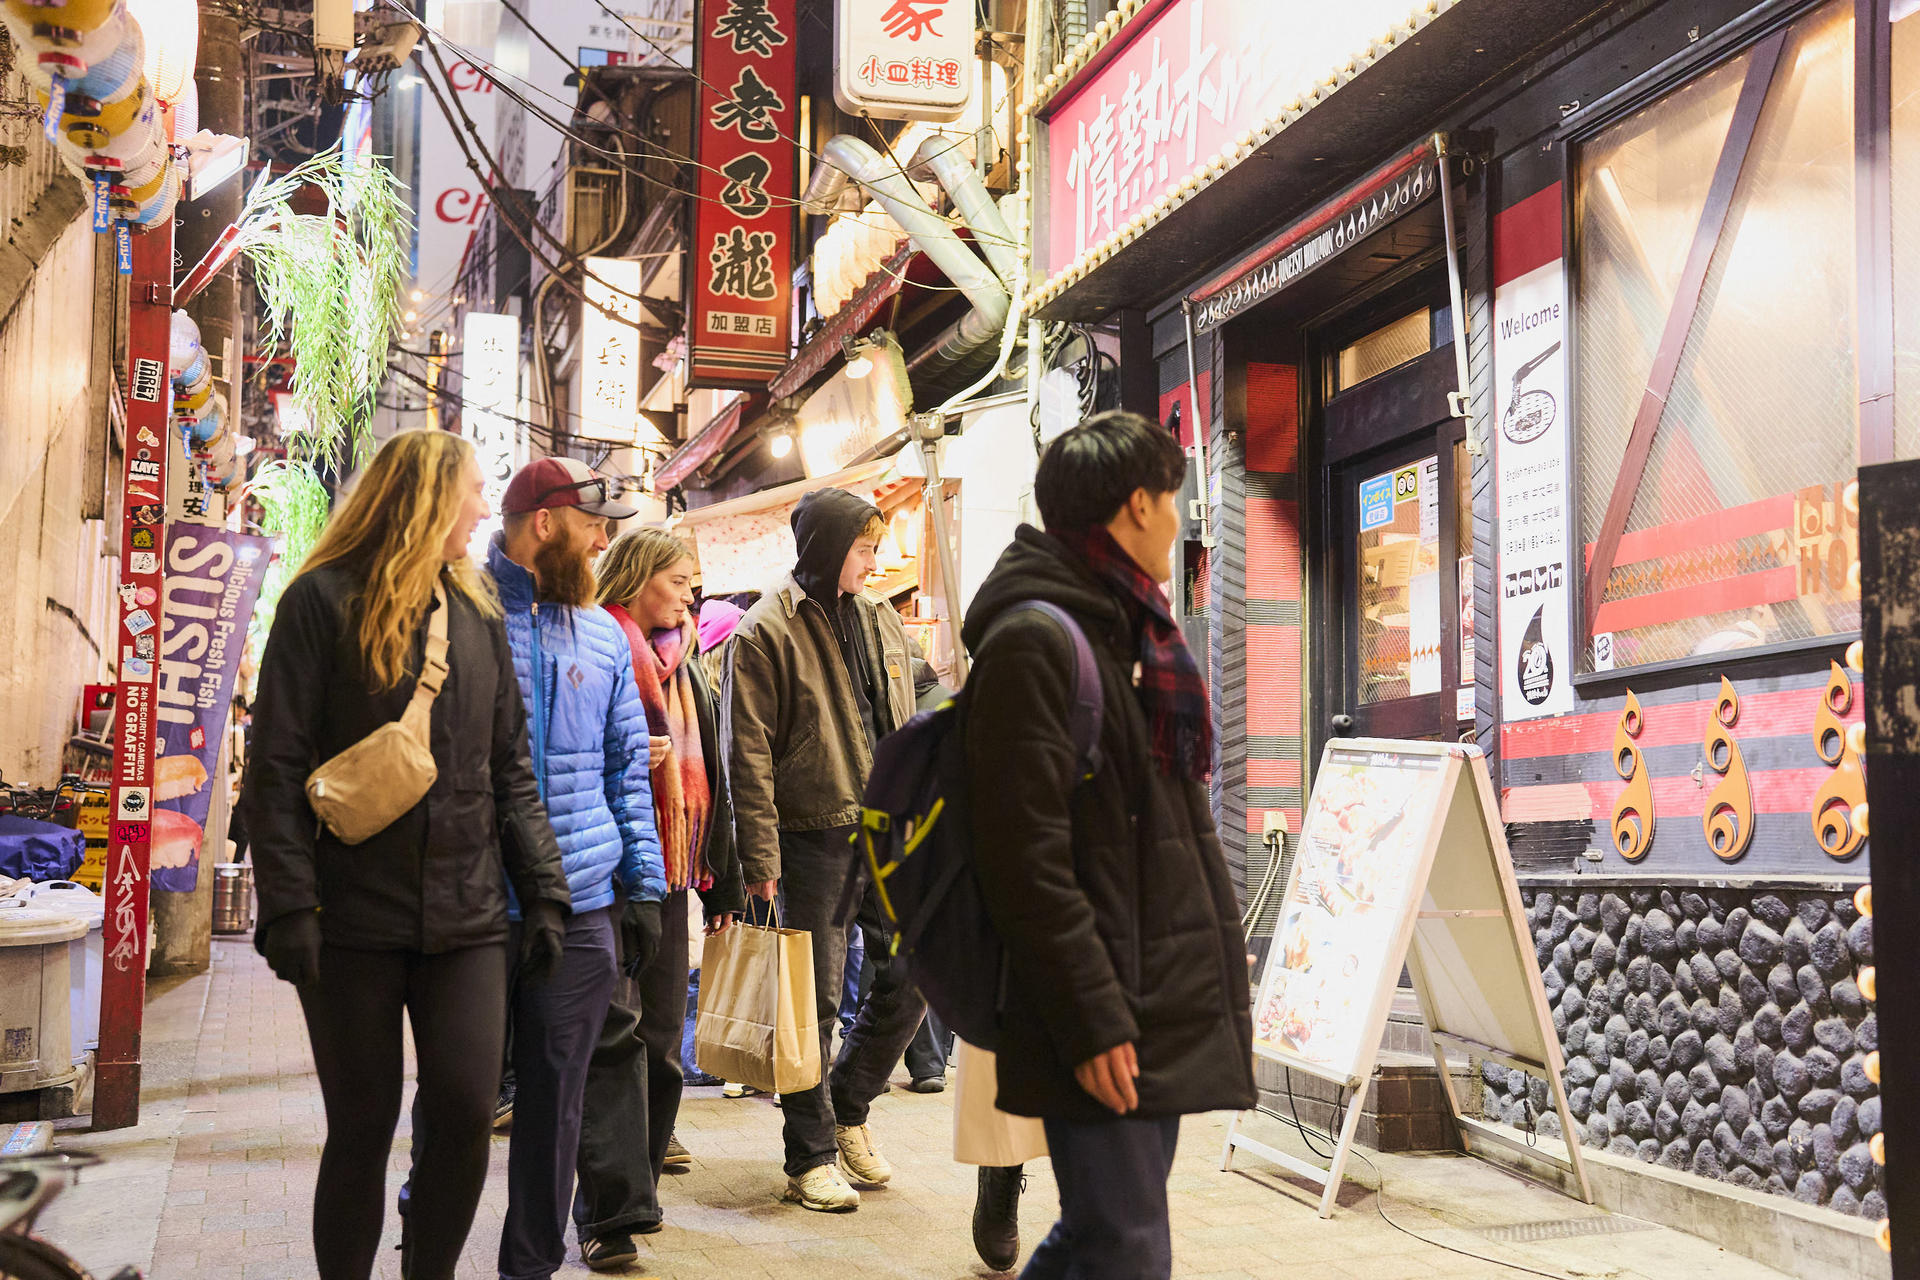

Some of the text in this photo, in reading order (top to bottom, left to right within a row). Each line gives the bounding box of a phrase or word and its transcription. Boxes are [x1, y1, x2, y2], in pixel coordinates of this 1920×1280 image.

[860, 57, 960, 87] 小皿料理
[709, 0, 788, 301] 養老乃瀧
[711, 313, 774, 335] 加盟店
[1501, 303, 1560, 340] Welcome
[219, 546, 262, 619] Delicious
[157, 535, 234, 725] SUSHI
[206, 620, 236, 670] Fresh
[127, 686, 139, 708] NO
[197, 672, 223, 709] Fish
[122, 712, 138, 781] GRAFFITI
[136, 686, 149, 781] 24h SECURITY CAMERAS
